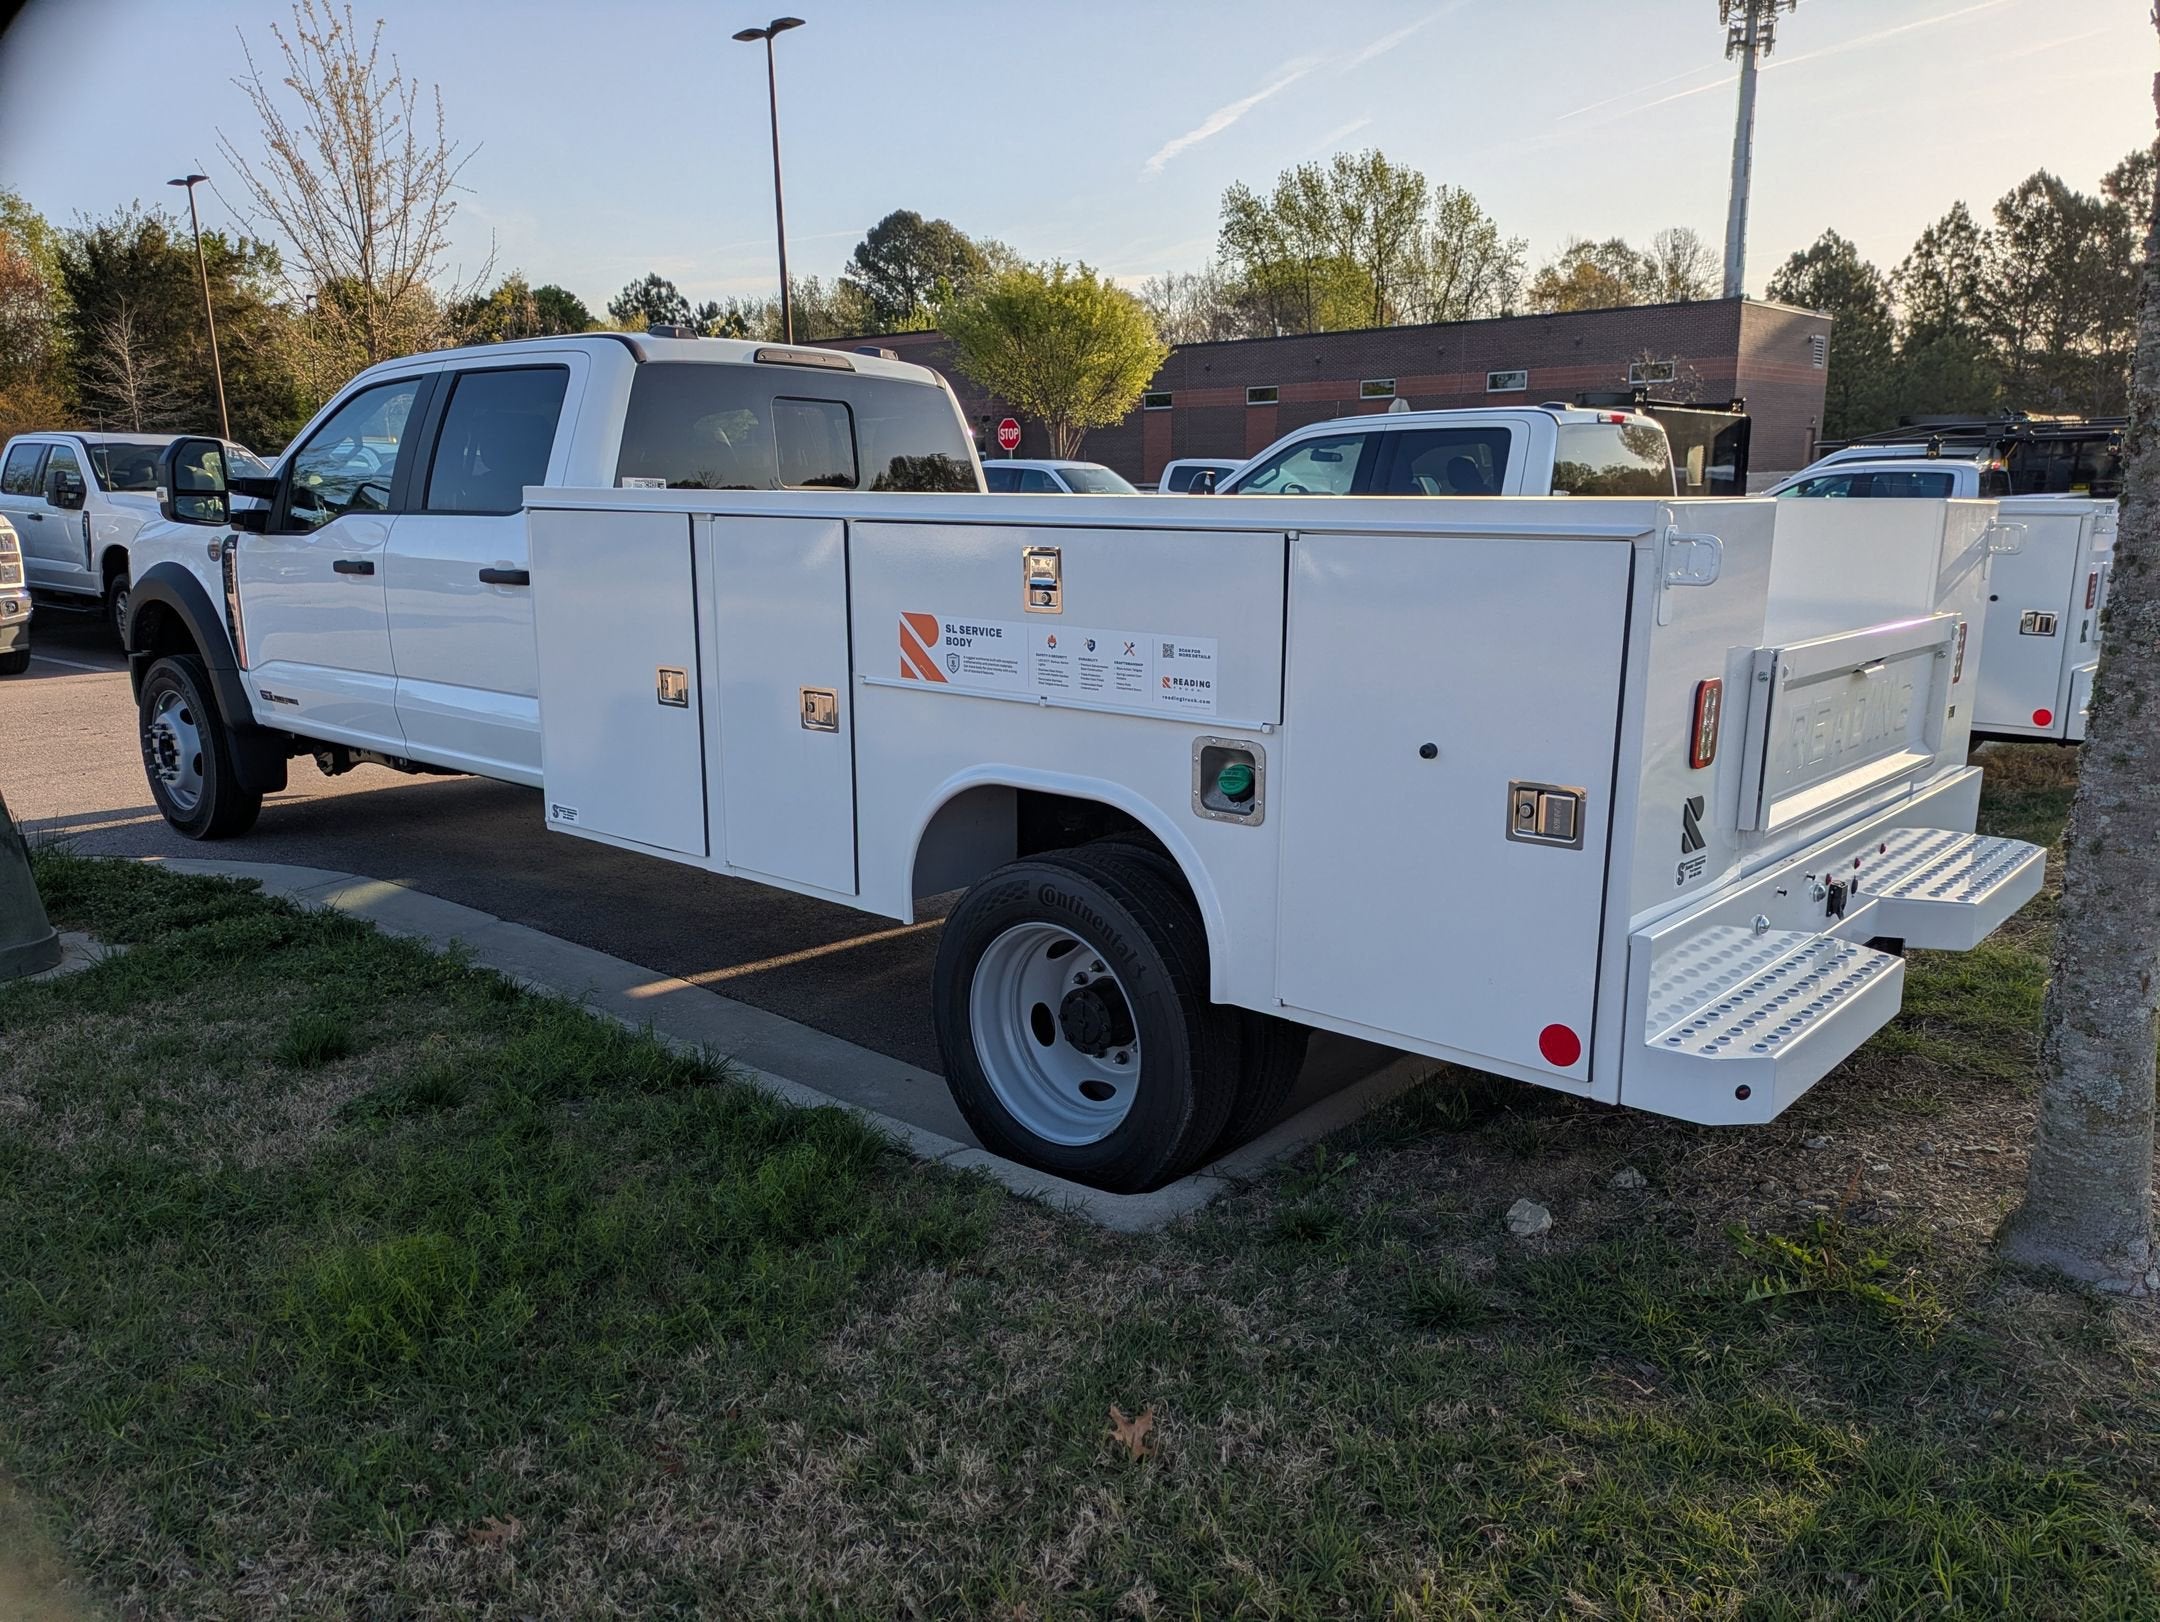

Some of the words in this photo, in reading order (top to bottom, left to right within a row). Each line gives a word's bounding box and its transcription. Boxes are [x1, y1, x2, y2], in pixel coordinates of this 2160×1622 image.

[1000, 427, 1019, 441] STOP
[945, 623, 958, 634] SL
[958, 625, 1003, 638] SERVICE
[945, 636, 973, 648] BODY
[1173, 677, 1211, 689] READING
[1785, 679, 1915, 773] READING
[1038, 883, 1138, 963] Continental
